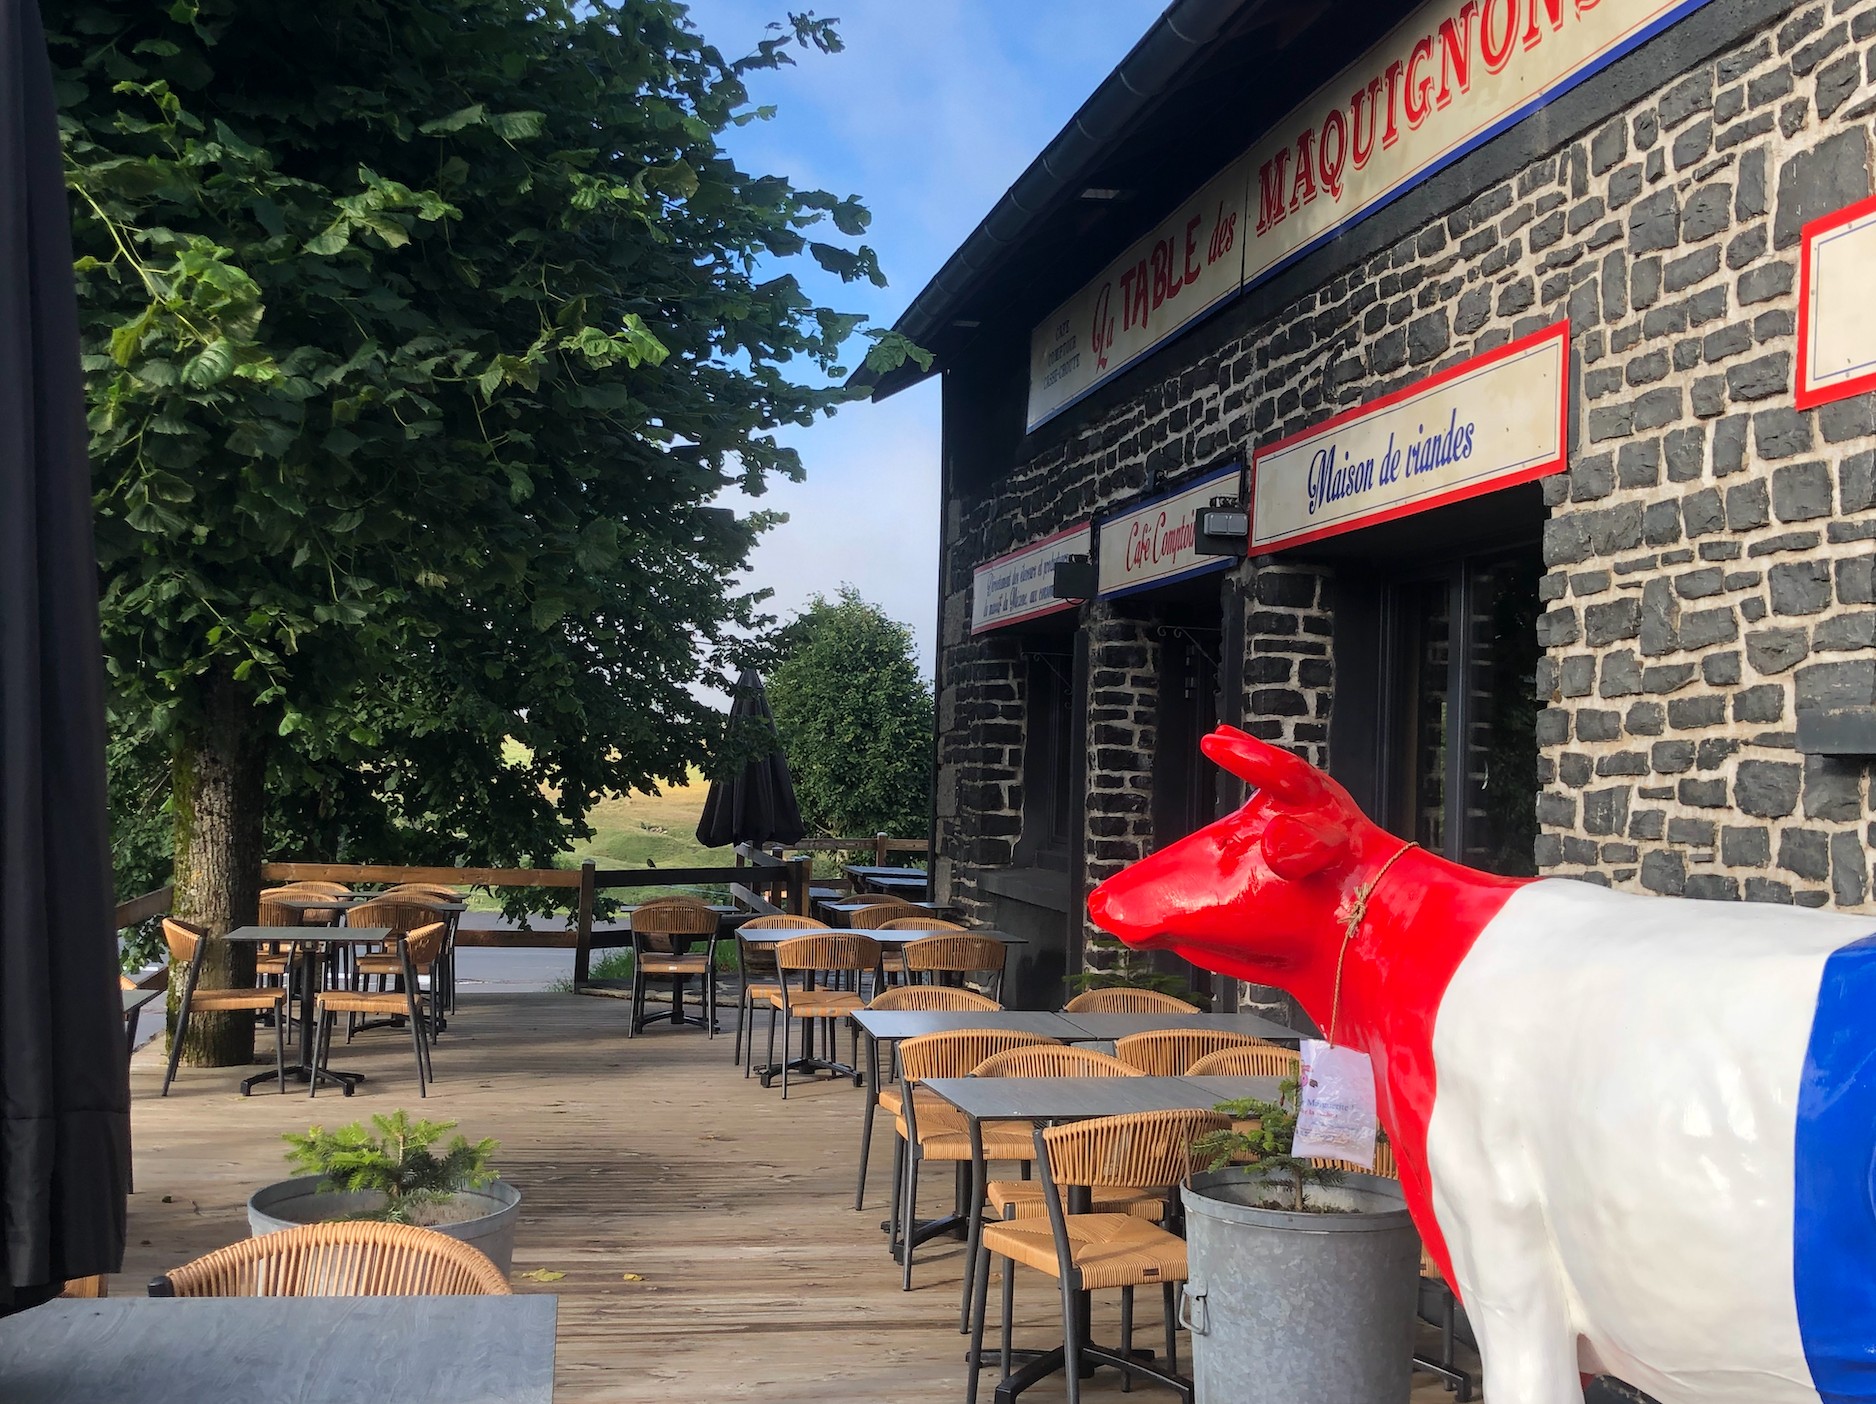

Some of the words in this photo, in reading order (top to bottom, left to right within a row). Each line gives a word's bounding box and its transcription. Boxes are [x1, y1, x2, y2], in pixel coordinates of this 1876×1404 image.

[1120, 214, 1202, 333] TABLE
[1208, 200, 1237, 266] des
[1256, 0, 1601, 238] MAQUIGNON
[1308, 444, 1374, 515] Maison
[1379, 432, 1401, 486] de
[1405, 408, 1475, 478] viandes
[1126, 521, 1152, 572] Café
[1152, 509, 1196, 564] Comptoi
